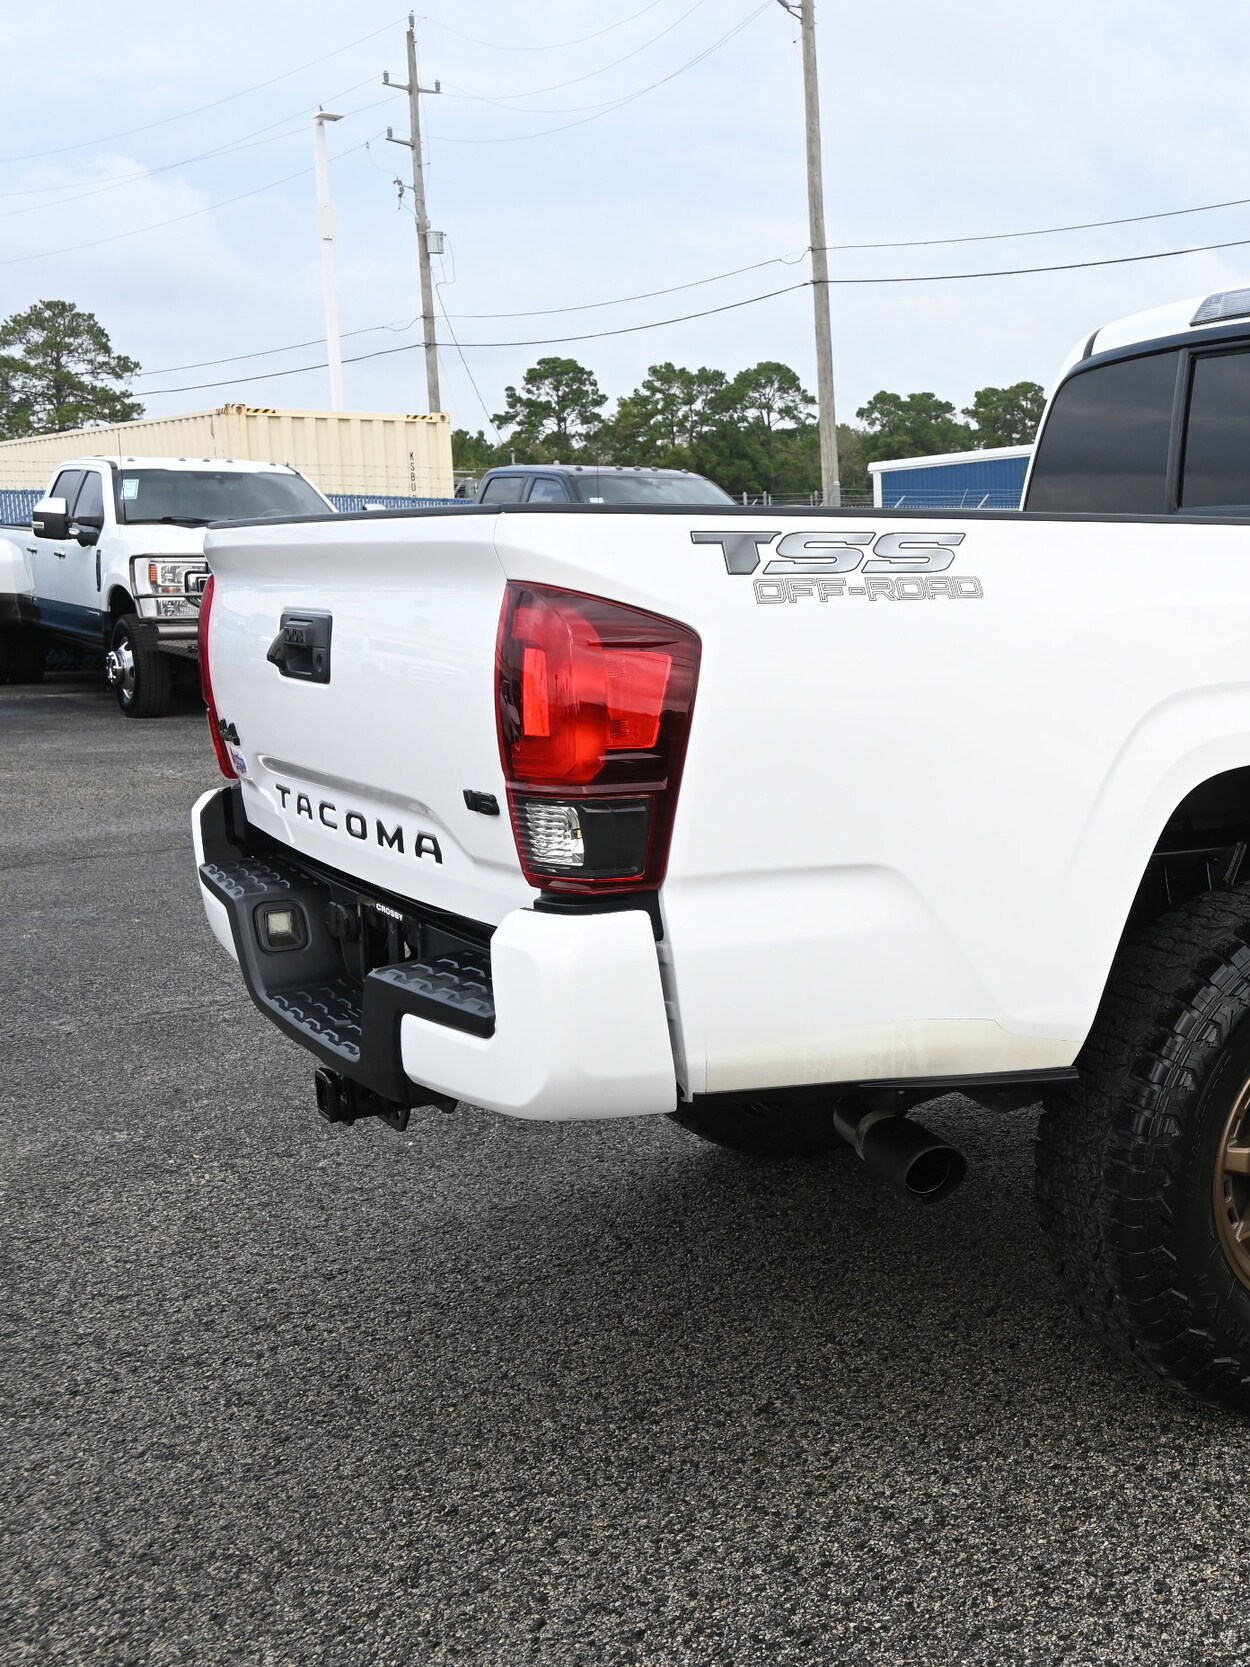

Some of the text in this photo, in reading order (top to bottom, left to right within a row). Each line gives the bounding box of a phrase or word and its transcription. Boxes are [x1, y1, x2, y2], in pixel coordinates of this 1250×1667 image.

[690, 531, 966, 575] TSS
[753, 576, 984, 604] OFF-ROAD
[275, 784, 443, 864] TACOMA
[376, 903, 403, 921] CROSBY
